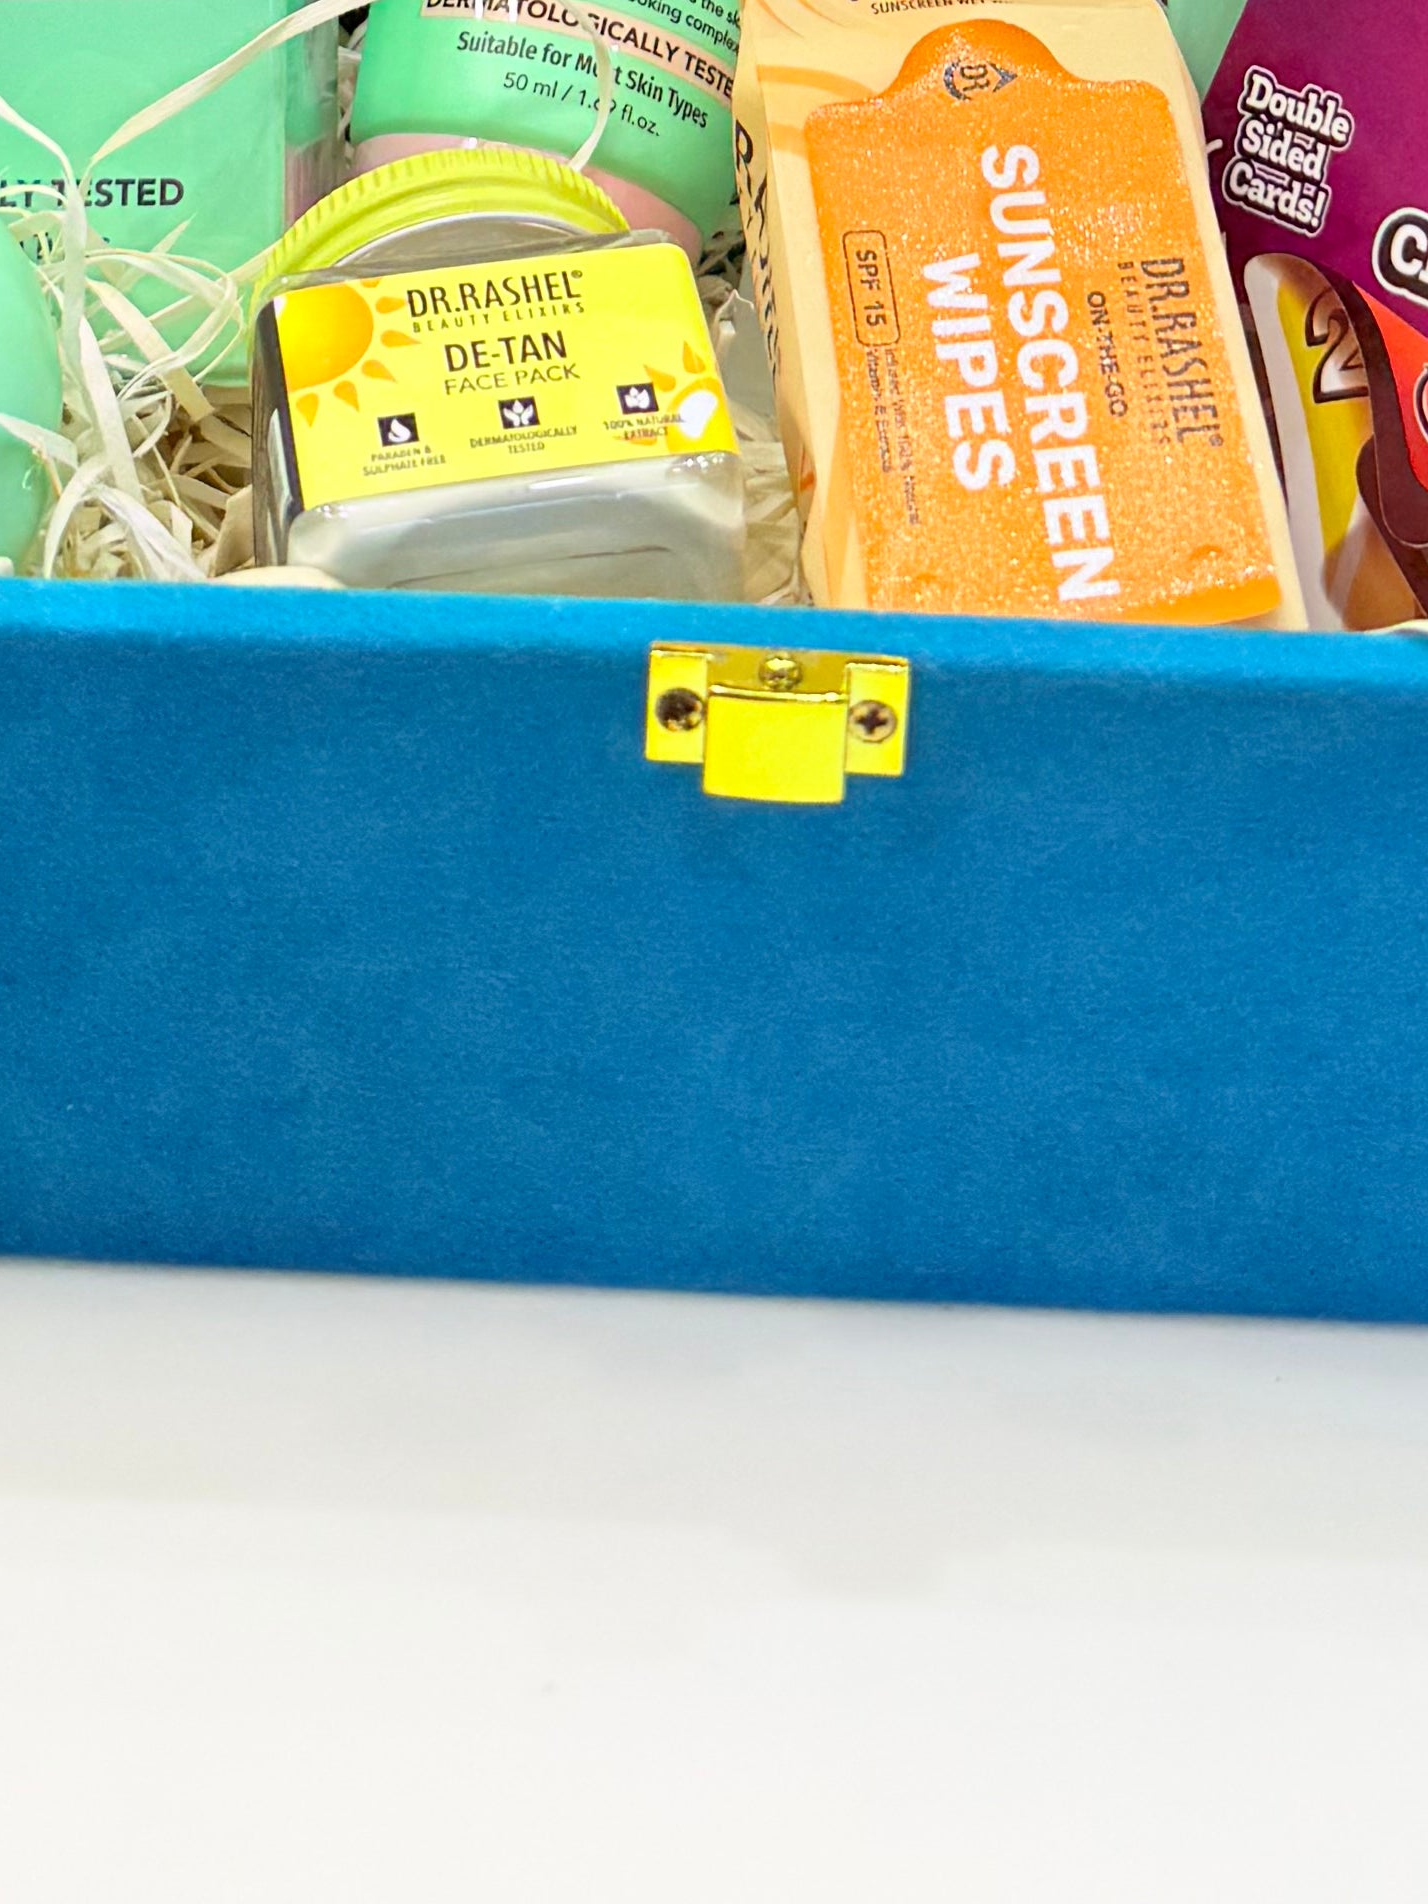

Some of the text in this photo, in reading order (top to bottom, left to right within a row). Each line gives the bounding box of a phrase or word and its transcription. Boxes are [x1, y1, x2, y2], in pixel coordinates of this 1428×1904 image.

[457, 30, 538, 62] Suitable
[542, 41, 574, 70] for
[625, 70, 664, 103] Skin
[669, 87, 709, 129] Types
[503, 71, 528, 92] 50
[532, 77, 559, 98] ml
[560, 84, 575, 102] /
[1246, 73, 1351, 142] Double
[1240, 116, 1327, 180] Sided
[1228, 164, 1327, 230] Cards!
[412, 301, 586, 333] BEAUTY ELIXIRS
[853, 248, 889, 330] SPF 15
[444, 329, 569, 374] DE-TAN
[444, 362, 581, 397] FACE PACK
[919, 252, 1016, 493] WIPES
[978, 142, 1121, 603] SUNSCREEN
[1086, 290, 1129, 420] ON-THE-GO
